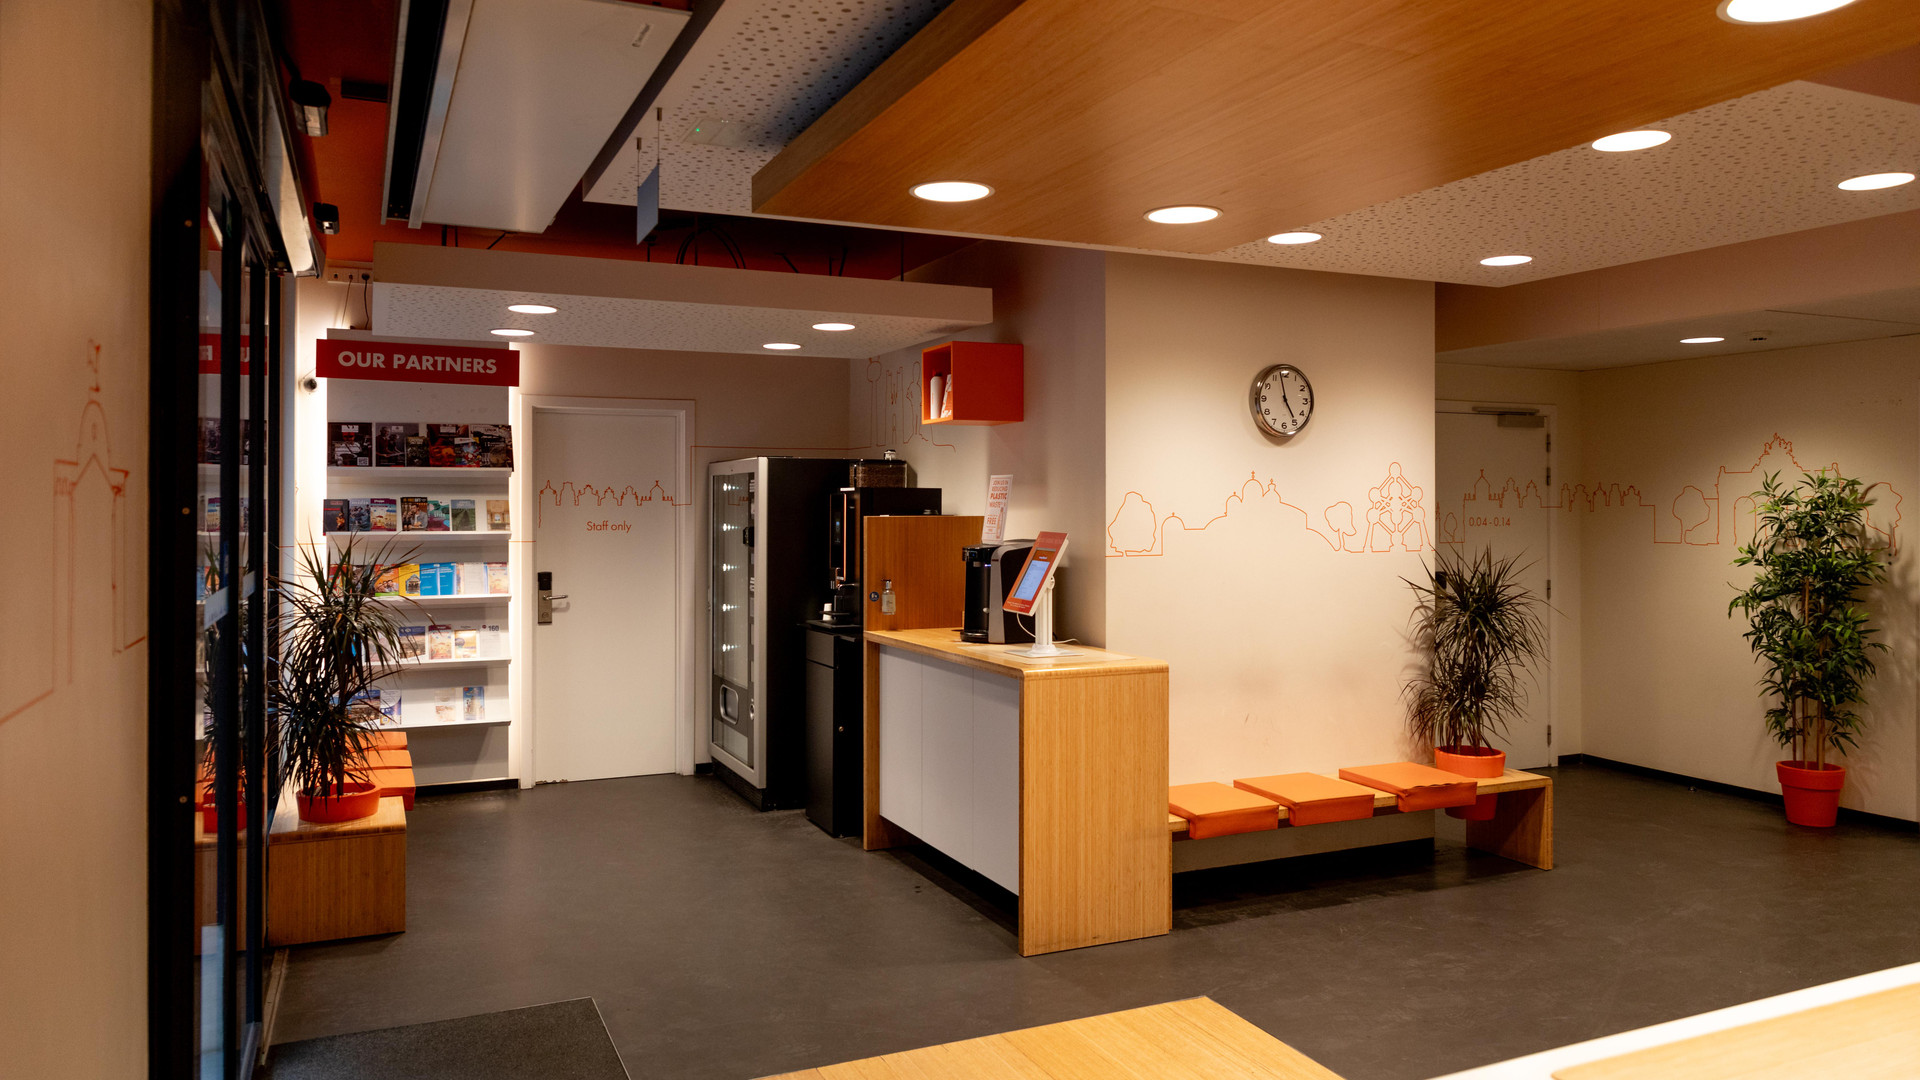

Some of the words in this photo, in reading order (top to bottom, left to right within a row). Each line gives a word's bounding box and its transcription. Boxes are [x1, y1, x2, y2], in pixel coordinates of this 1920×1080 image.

[338, 350, 386, 369] OUR
[393, 353, 497, 374] PARTNERS
[586, 520, 608, 531] Staff
[610, 520, 632, 534] only
